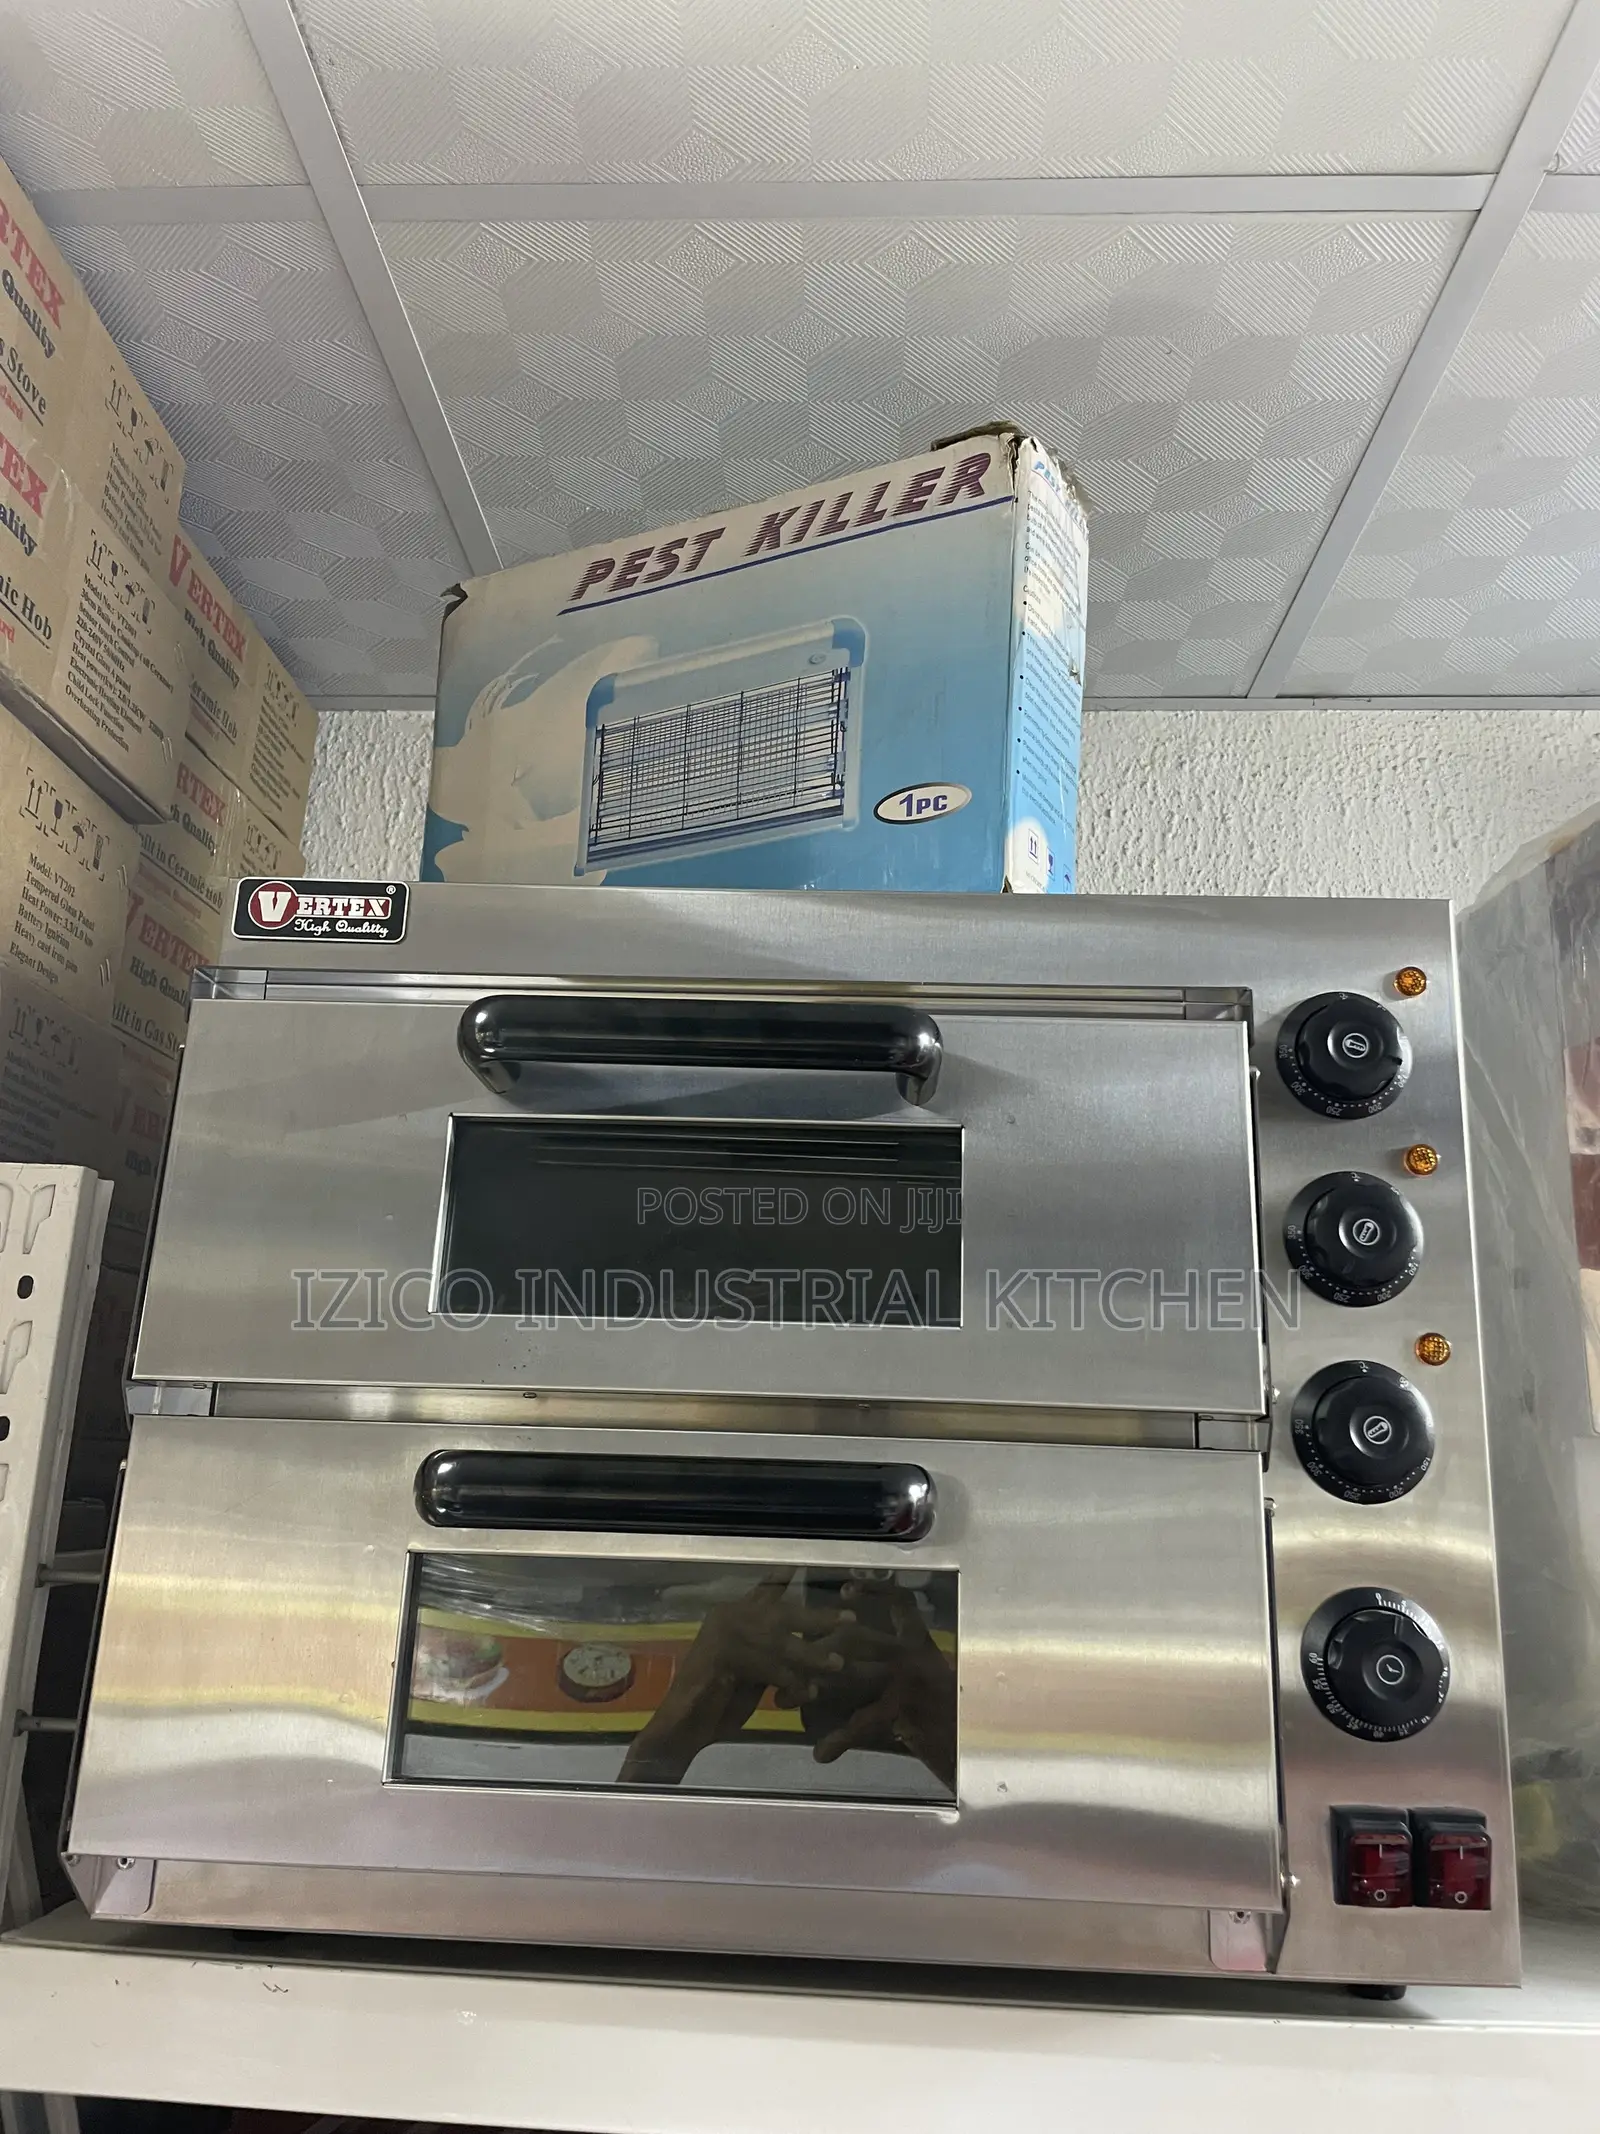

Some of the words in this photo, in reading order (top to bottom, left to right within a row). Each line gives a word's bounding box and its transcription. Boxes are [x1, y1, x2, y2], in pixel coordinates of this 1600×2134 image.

[2, 269, 56, 358] Quality
[7, 347, 46, 415] Stove
[567, 527, 726, 601] PEST
[740, 452, 992, 557] KILLER
[21, 592, 52, 640] Hob
[169, 534, 247, 664] VERTEX
[207, 639, 240, 690] Quality
[65, 684, 101, 728] Overheating
[67, 670, 85, 694] Child
[84, 686, 100, 709] Lock
[899, 793, 947, 817] 1PC
[182, 811, 217, 857] Quality
[29, 852, 53, 880] Model:
[167, 853, 205, 896] Ceramic
[22, 886, 39, 909] Heat
[25, 869, 60, 905] Tempered
[18, 902, 44, 932] Battery
[257, 890, 387, 922] VERTEX
[14, 920, 35, 947] Heavy
[294, 918, 331, 937] High
[9, 941, 37, 970] Elegant
[130, 955, 157, 989] High
[143, 1016, 165, 1047] Gas
[1308, 1652, 1318, 1664] 60
